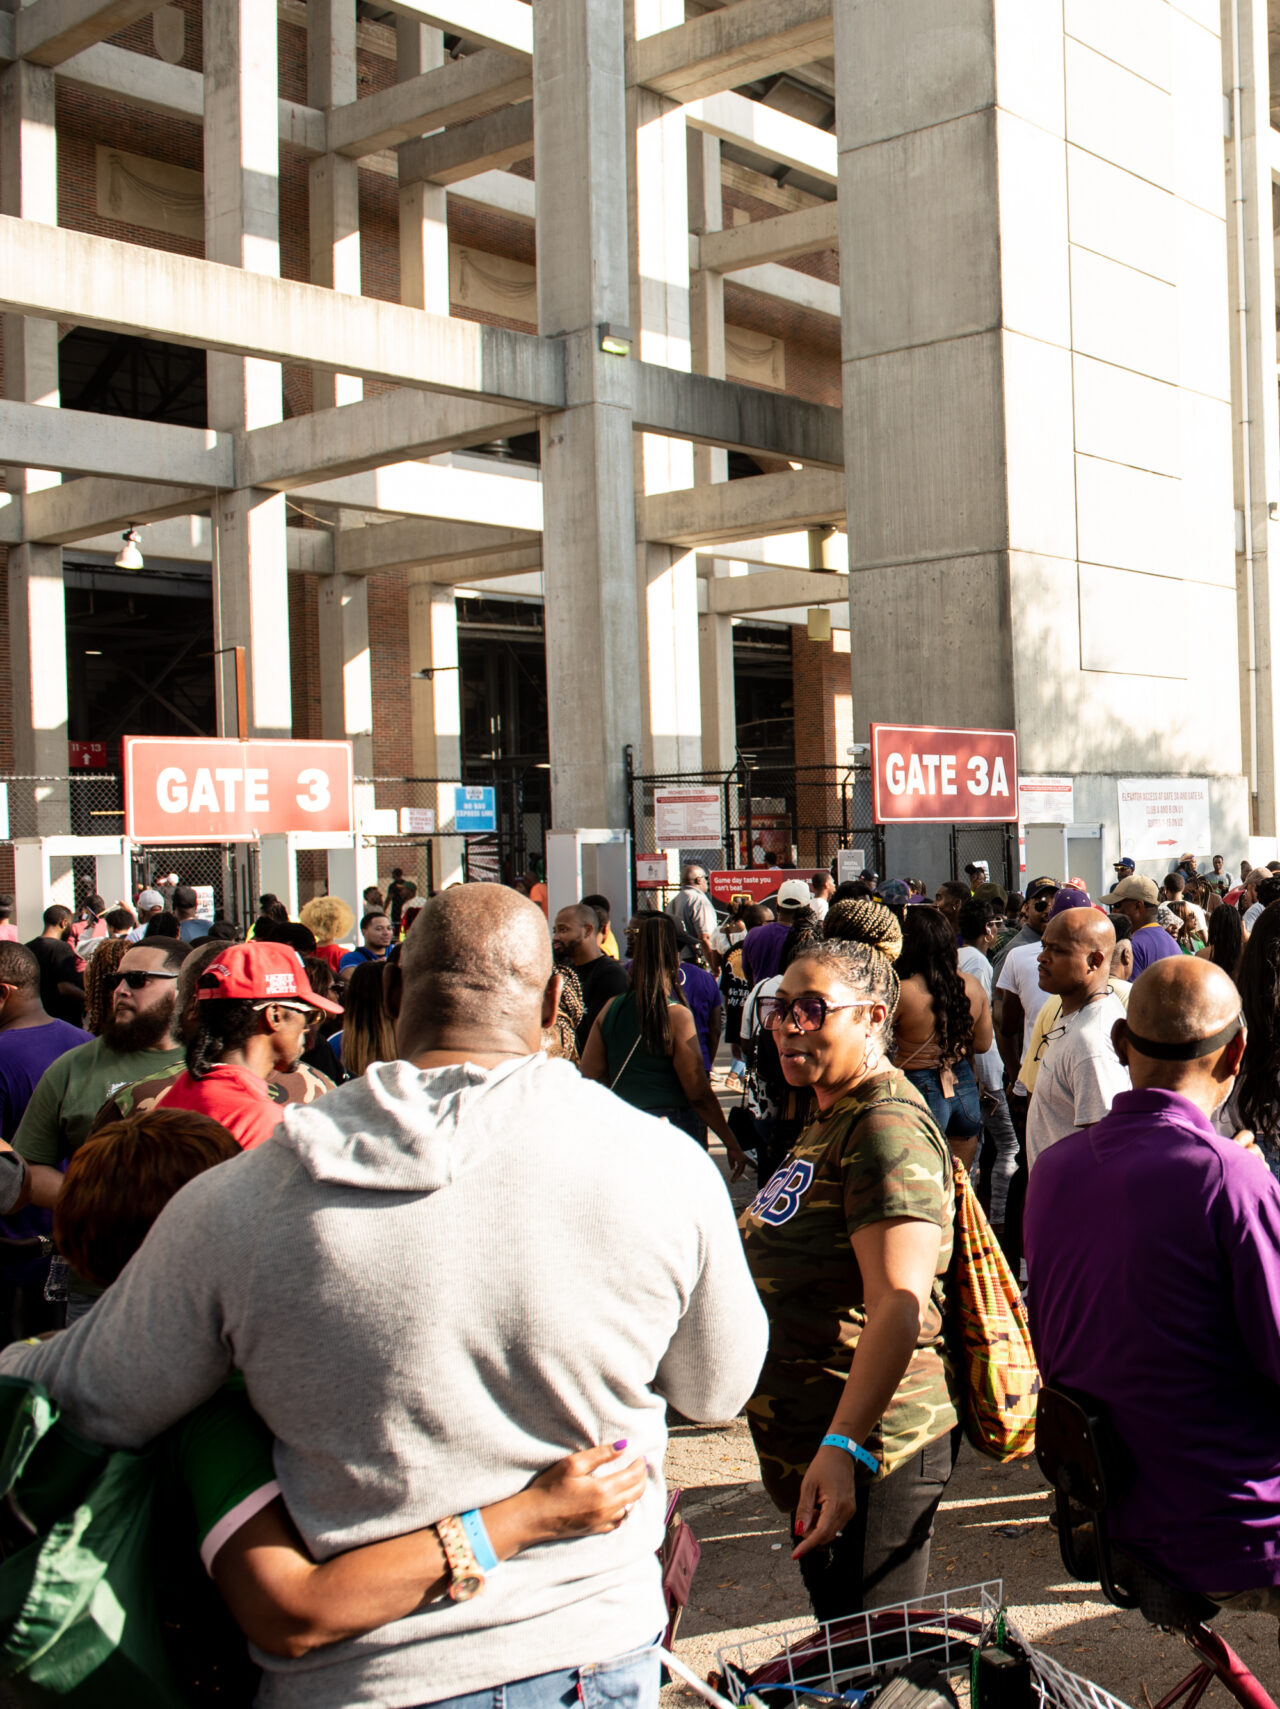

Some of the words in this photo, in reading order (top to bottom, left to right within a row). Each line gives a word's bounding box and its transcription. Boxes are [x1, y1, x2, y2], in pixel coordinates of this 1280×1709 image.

[72, 744, 80, 752] 11
[90, 744, 102, 752] 13
[885, 752, 958, 796] GATE
[966, 755, 1010, 797] 3A
[156, 767, 270, 814] GATE
[295, 768, 331, 813] 3
[732, 876, 742, 885] day
